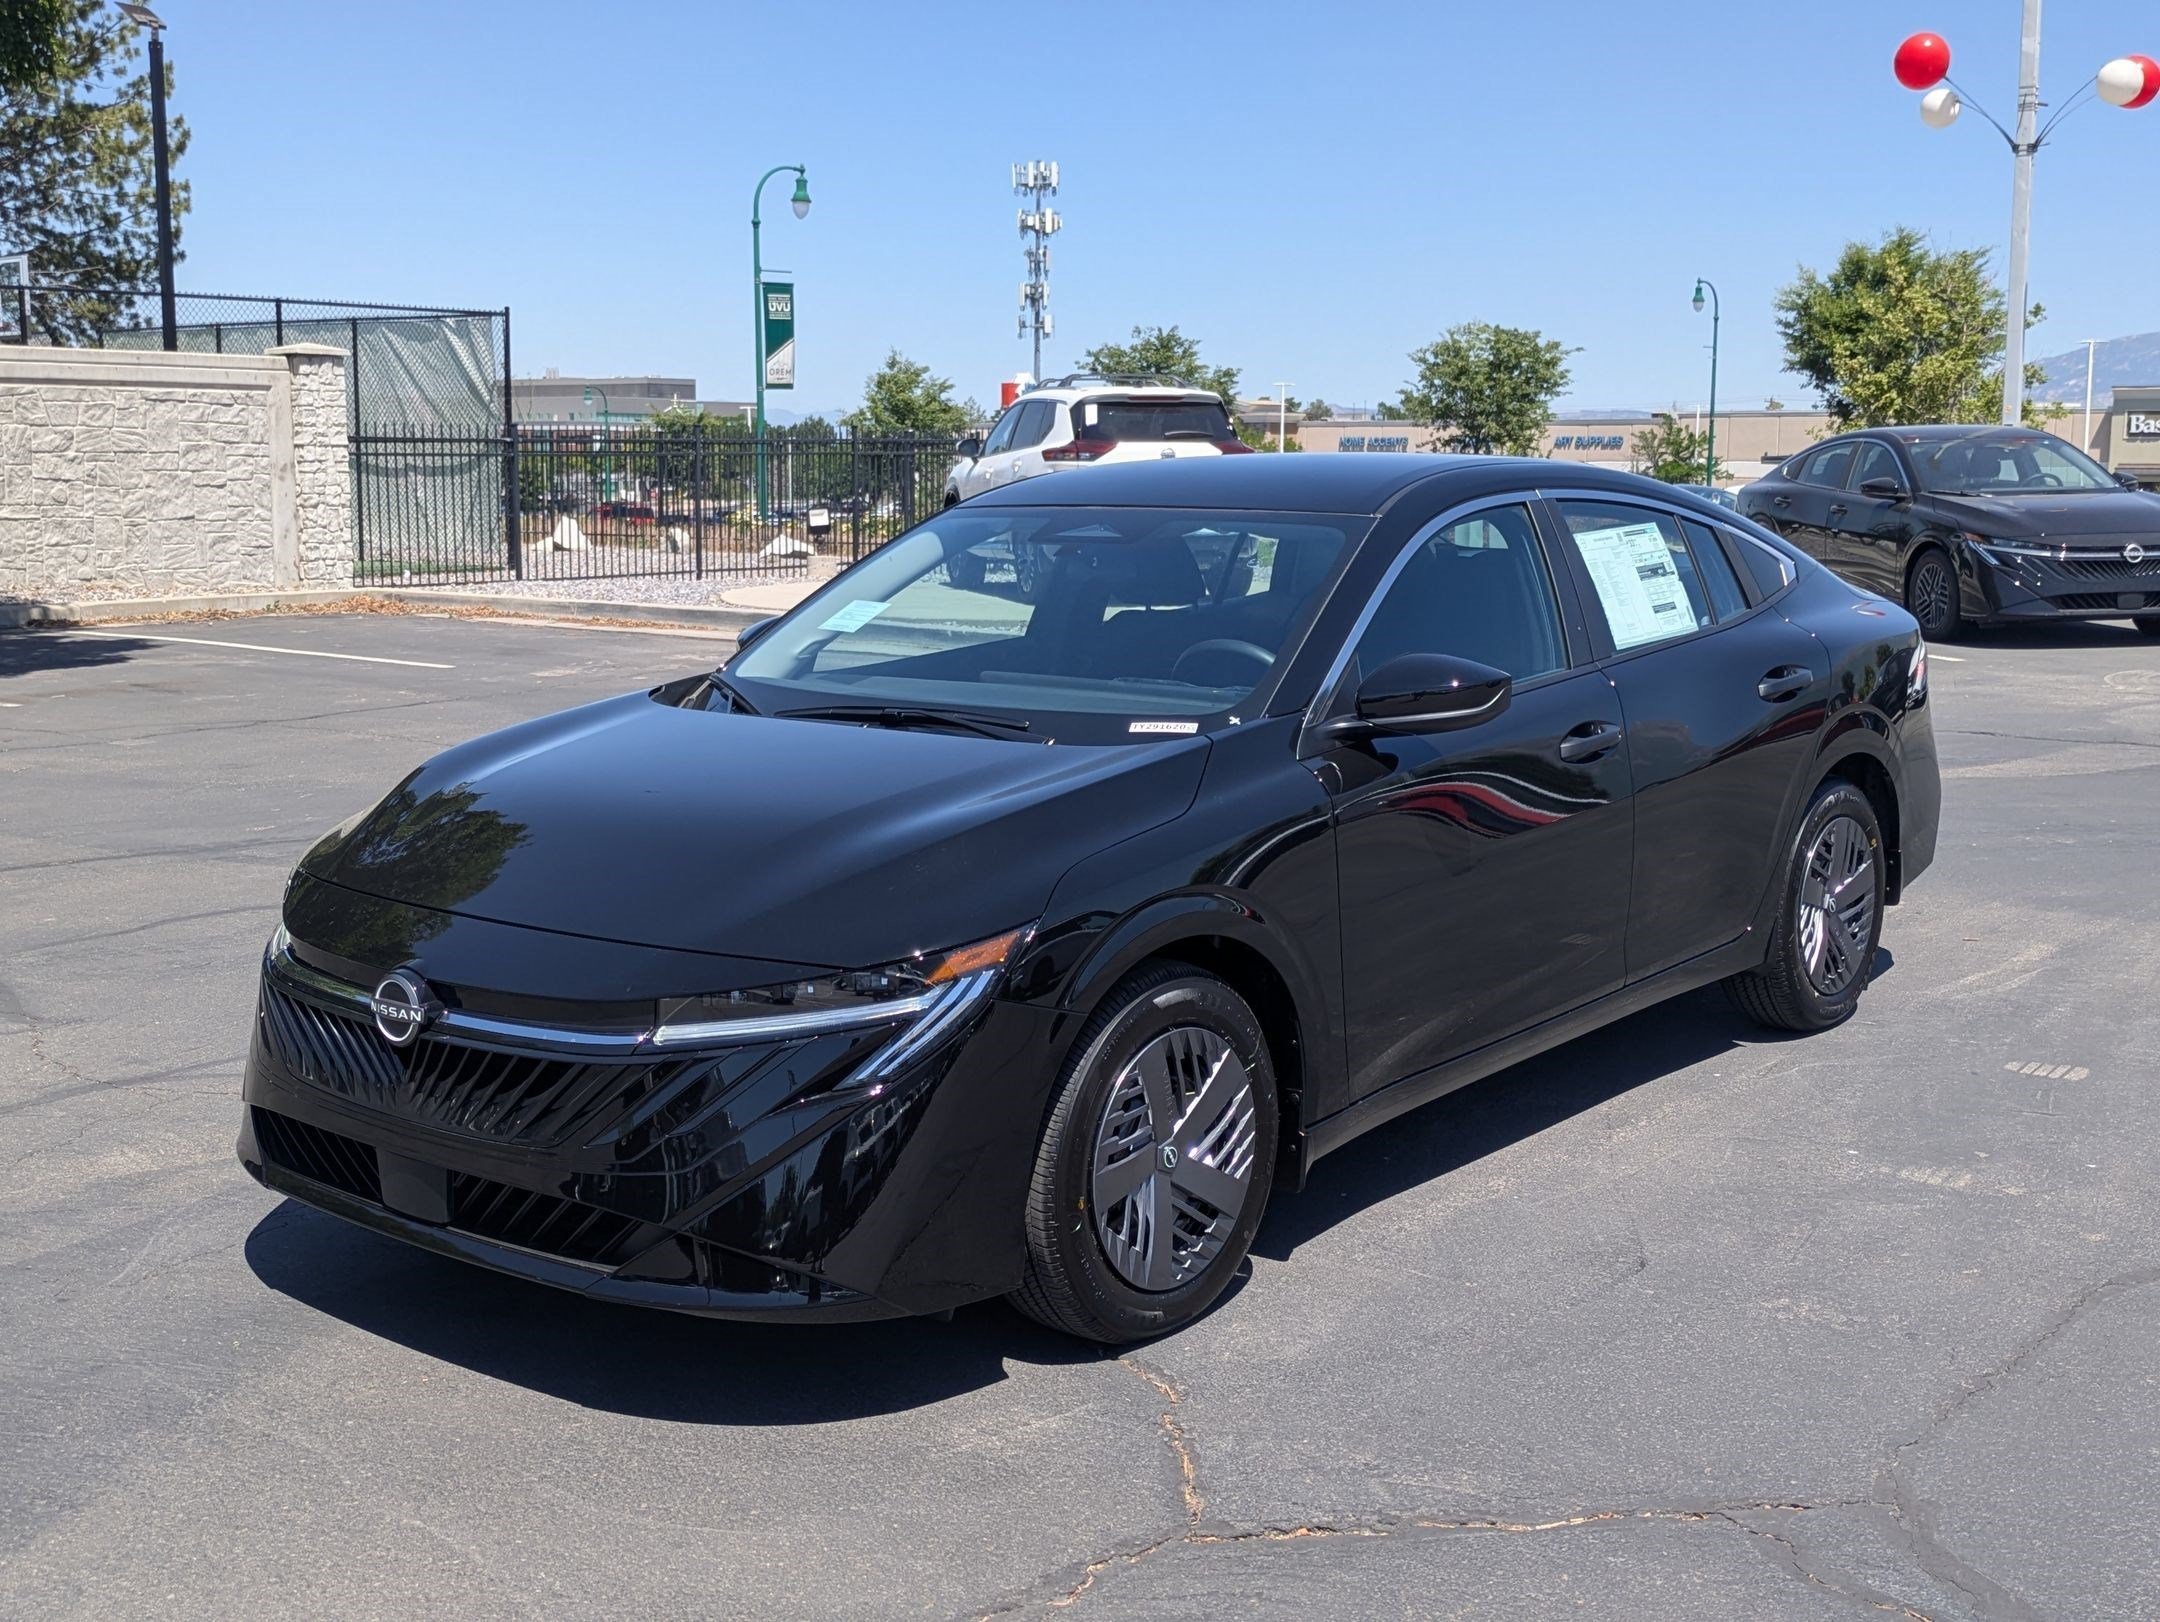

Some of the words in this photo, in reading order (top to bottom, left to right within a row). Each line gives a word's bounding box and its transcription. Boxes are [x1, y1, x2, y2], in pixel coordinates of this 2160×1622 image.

[768, 301, 791, 312] UVU
[769, 368, 792, 376] OREM
[1339, 436, 1365, 448] HOME
[1367, 436, 1409, 448] ACCENTS
[1555, 436, 1574, 448] ART
[1575, 436, 1624, 448] SUPPLIES
[371, 1000, 421, 1022] NISSAN
